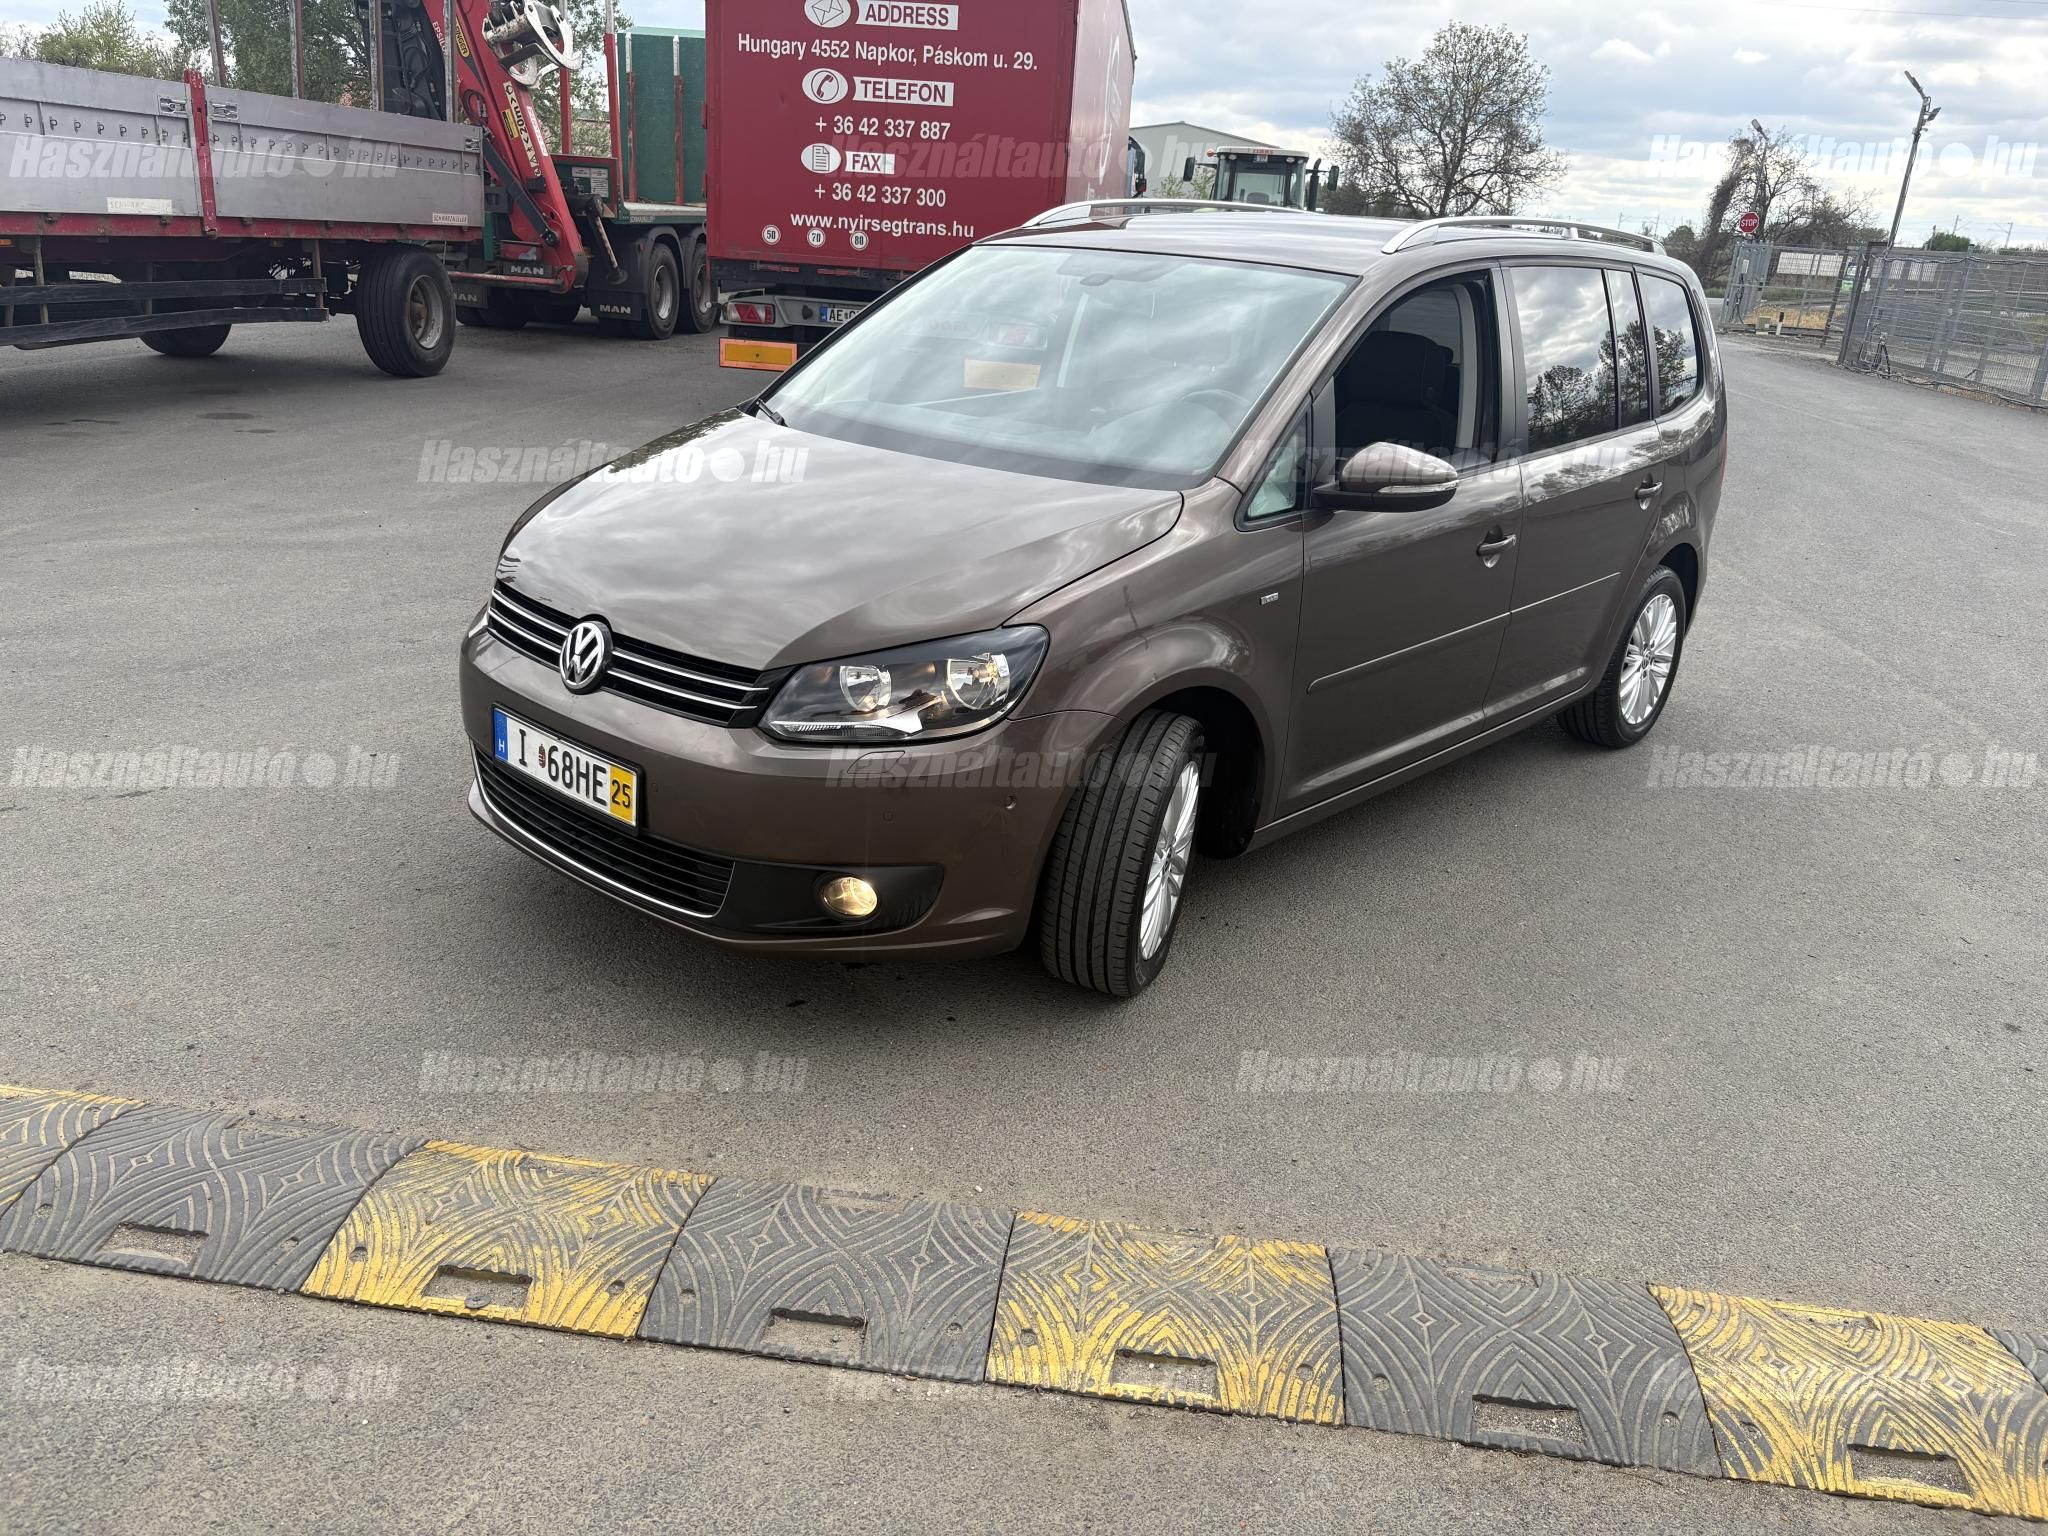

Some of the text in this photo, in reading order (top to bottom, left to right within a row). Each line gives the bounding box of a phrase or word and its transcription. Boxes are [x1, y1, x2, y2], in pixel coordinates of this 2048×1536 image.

[865, 4, 949, 27] ADDRESS
[738, 33, 1038, 70] Hungary 4552 Napkor, Páskom u. 29.
[860, 80, 946, 103] TELEFON
[833, 115, 854, 135] 36
[858, 117, 879, 136] 42
[884, 119, 915, 138] 337
[920, 121, 951, 140] 887
[852, 153, 881, 171] FAX
[832, 182, 852, 201] 36
[856, 184, 877, 202] 42
[881, 186, 912, 204] 337
[916, 188, 946, 207] 300
[790, 213, 975, 238] www.nyirsegtrans.hu
[1740, 215, 1757, 228] STOP
[766, 230, 776, 240] 50
[811, 233, 821, 243] 70
[854, 235, 864, 246] 80
[510, 265, 544, 275] MAN
[600, 304, 632, 314] MAN
[828, 308, 847, 322] AE
[498, 728, 632, 809] H I 68HE 25
